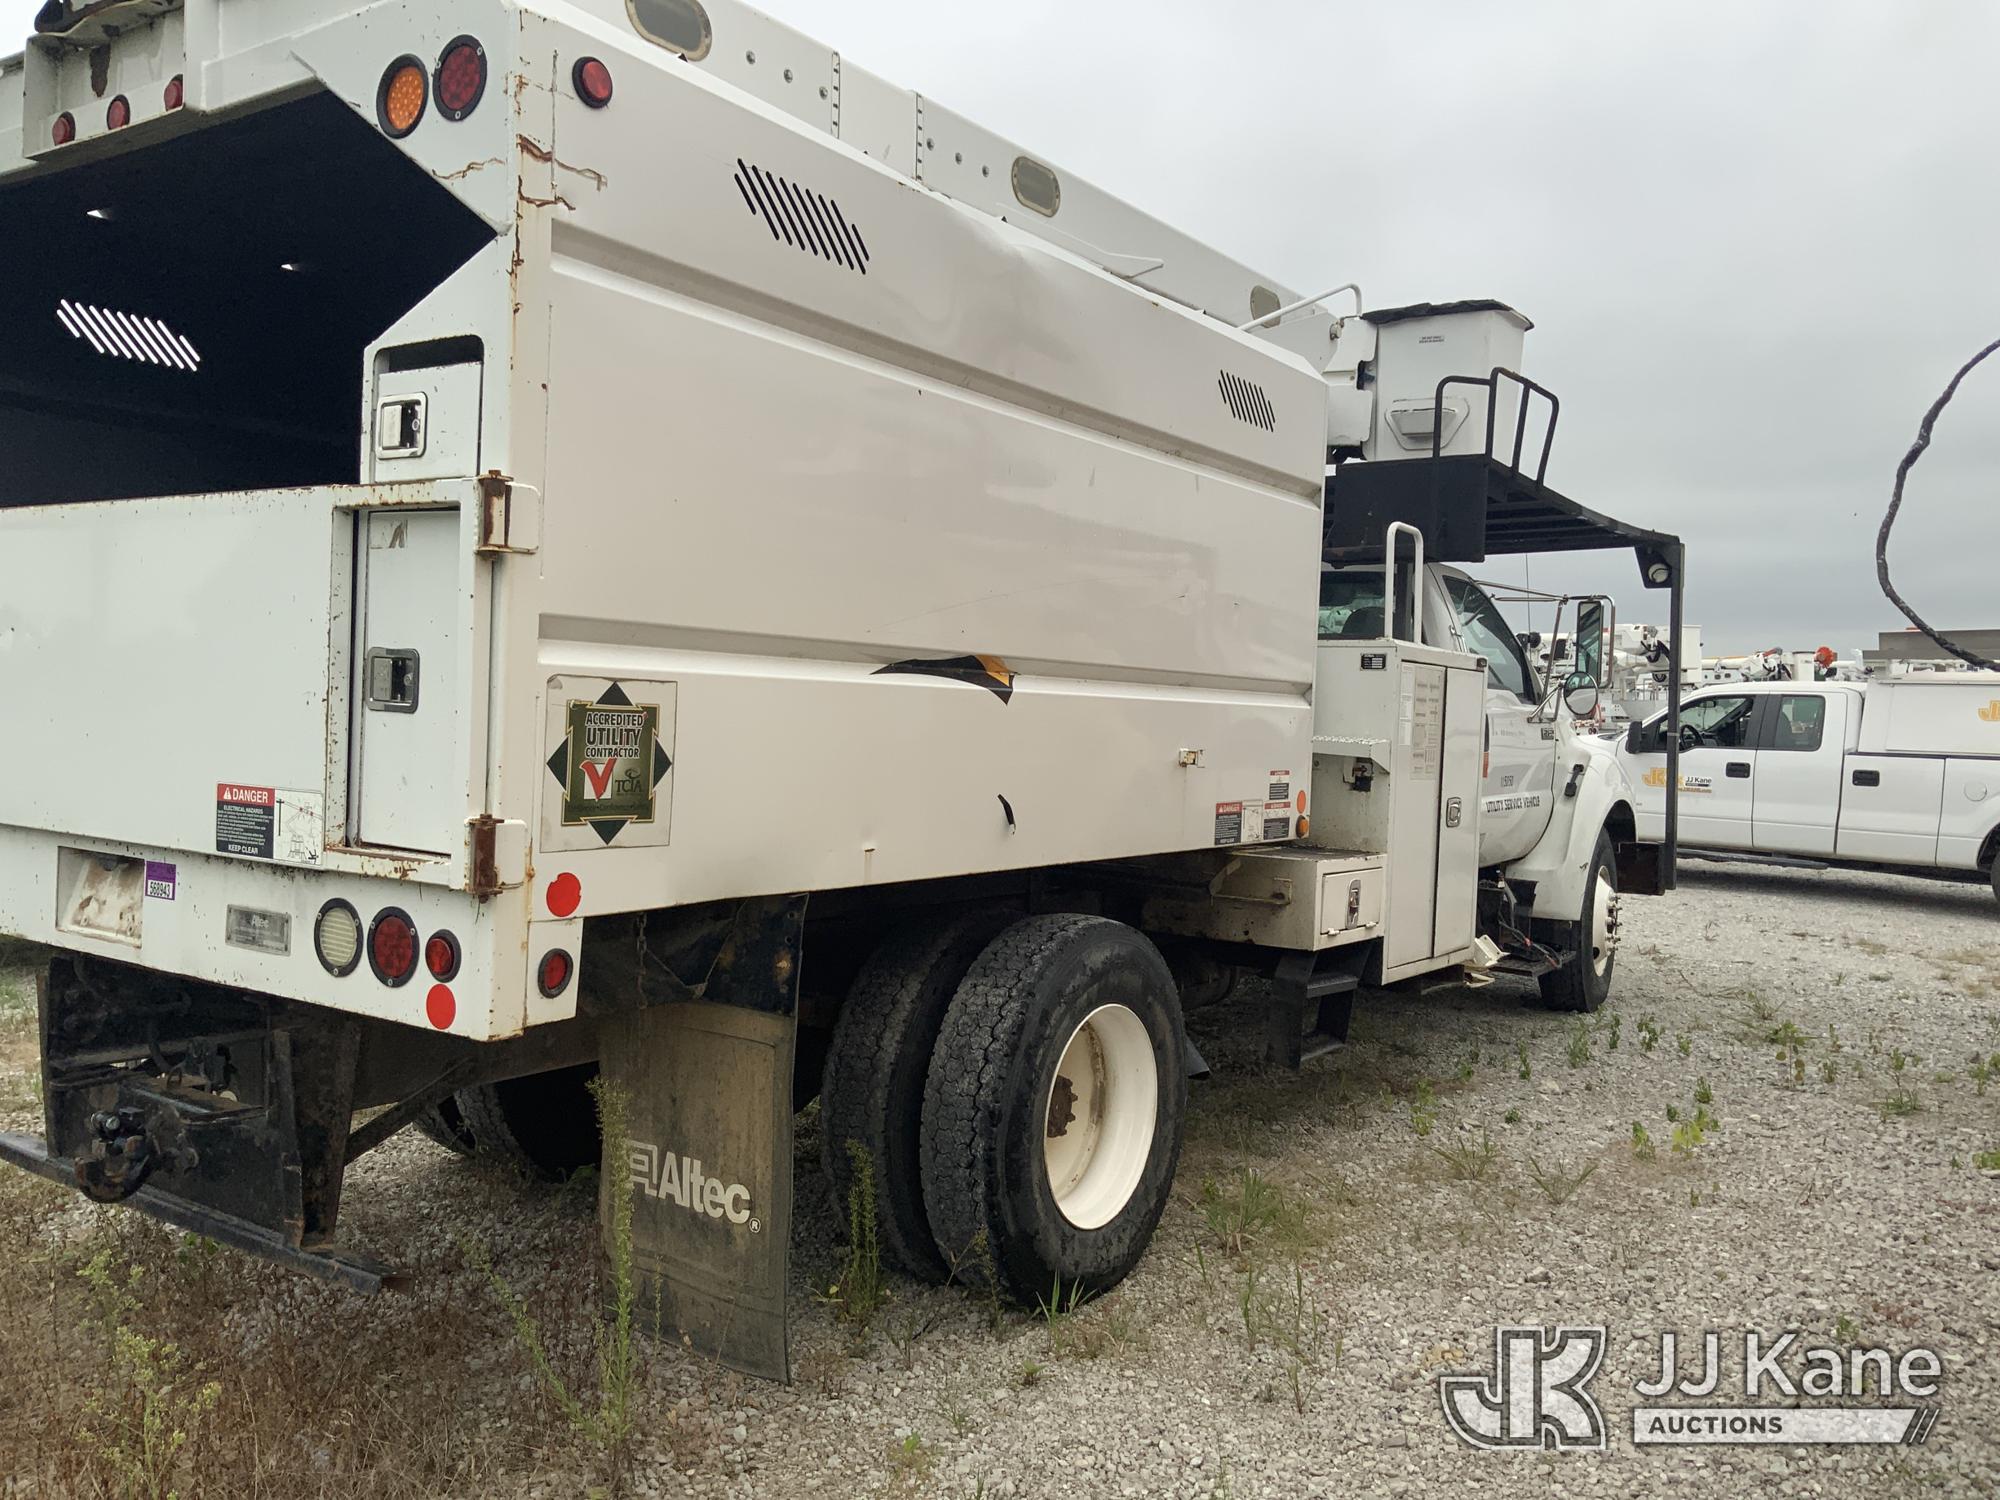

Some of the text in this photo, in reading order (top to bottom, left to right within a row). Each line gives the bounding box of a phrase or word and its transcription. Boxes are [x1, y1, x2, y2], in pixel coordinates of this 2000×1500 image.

[585, 711, 644, 727] ACCREDITED
[586, 727, 642, 746] UTILITY
[585, 747, 640, 758] CONTRACTOR
[232, 788, 269, 804] DANGER
[1486, 795, 1541, 813] UTILITY SERVICE VEHICLE
[228, 844, 259, 856] KEEP CLEAR
[658, 1151, 752, 1225] Altec
